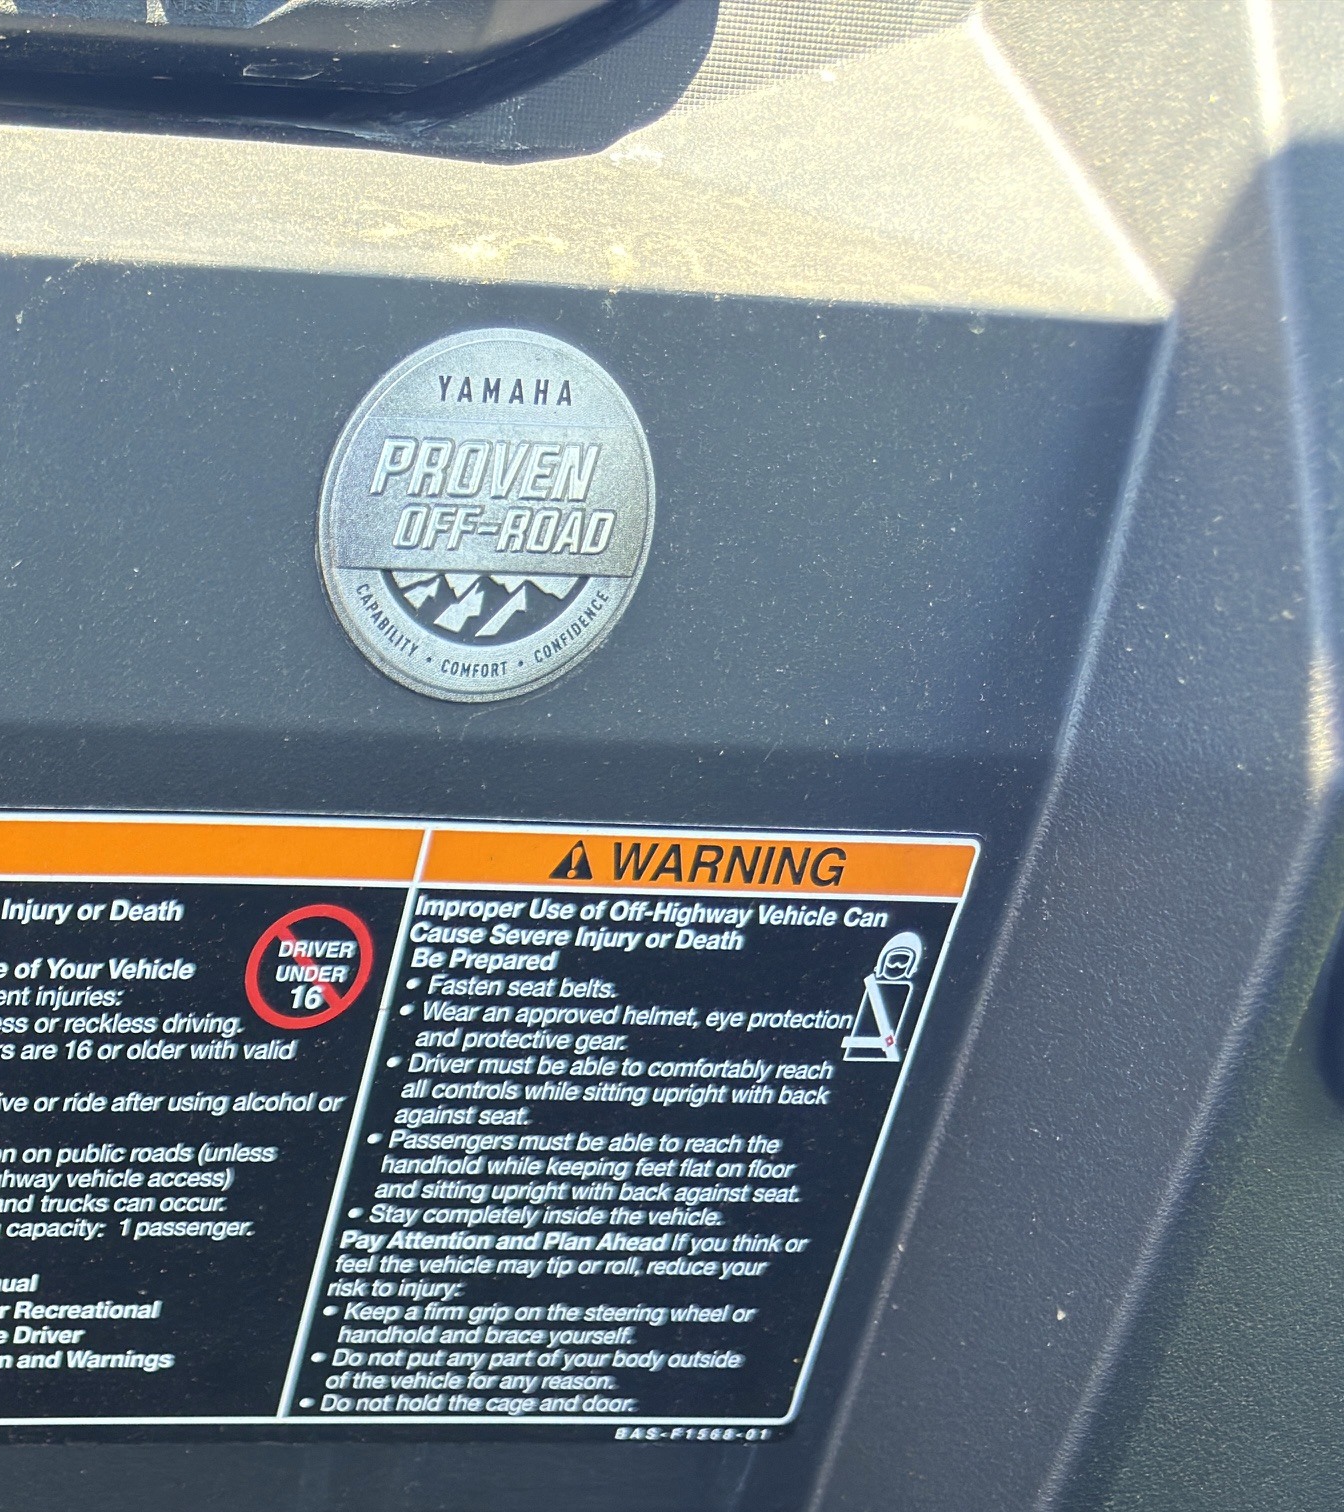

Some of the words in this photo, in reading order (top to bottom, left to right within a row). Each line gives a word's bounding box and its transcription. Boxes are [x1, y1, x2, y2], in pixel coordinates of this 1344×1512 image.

[439, 376, 572, 406] YAMAHA
[370, 436, 602, 502] PROVEN
[392, 503, 617, 555] OFF-ROAD
[356, 583, 420, 658] CAPABILITY
[441, 658, 507, 678] COMFORT
[534, 589, 610, 664] CONFIDENCE
[613, 842, 846, 887] WARNING
[1, 901, 72, 924] Injury
[77, 905, 104, 920] or
[109, 901, 183, 921] Death
[414, 895, 526, 922] Improper
[529, 897, 576, 919] Use
[579, 900, 608, 920] of
[609, 900, 753, 928] Off-Highway
[758, 904, 837, 926] Vehicle
[843, 906, 888, 927] Can
[278, 940, 357, 958] DRIVER
[410, 922, 487, 945] Cause
[489, 923, 571, 946] Severe
[574, 926, 643, 951] Injury
[645, 932, 673, 948] or
[674, 928, 743, 950] Death
[14, 957, 42, 978] of
[47, 958, 104, 979] Your
[108, 958, 195, 979] Vehicle
[410, 946, 445, 968] Be
[448, 947, 559, 973] Prepared
[275, 964, 350, 983] UNDER
[427, 973, 502, 995] Fasten
[506, 978, 556, 997] seat
[558, 977, 616, 998] belts.
[35, 985, 123, 1010] injuries:
[291, 985, 325, 1010] 16
[33, 1017, 61, 1033] or
[63, 1013, 157, 1033] reckless
[162, 1012, 243, 1037] driving.
[20, 1044, 57, 1059] are
[65, 1039, 93, 1059] 16
[97, 1044, 123, 1059] or
[126, 1039, 186, 1059] older
[190, 1039, 235, 1059] with
[243, 1039, 296, 1059] valid
[414, 1027, 460, 1047] and
[461, 1029, 571, 1051] protective
[573, 1034, 626, 1054] gear.
[394, 1104, 476, 1128] against
[477, 1107, 528, 1125] seat.
[66, 1168, 144, 1187] vehicle
[147, 1168, 232, 1191] access)
[368, 1203, 419, 1227] Stay
[422, 1205, 539, 1228] completely
[542, 1205, 607, 1224] inside
[609, 1206, 644, 1225] the
[648, 1207, 721, 1225] vehicle.
[13, 1300, 162, 1319] Recreational
[12, 1325, 85, 1343] Driver
[337, 1325, 438, 1343] handhold
[439, 1325, 483, 1343] and
[484, 1326, 546, 1343] brace
[546, 1326, 631, 1348] yourself.
[16, 1350, 62, 1368] and
[66, 1349, 174, 1371] Warnings
